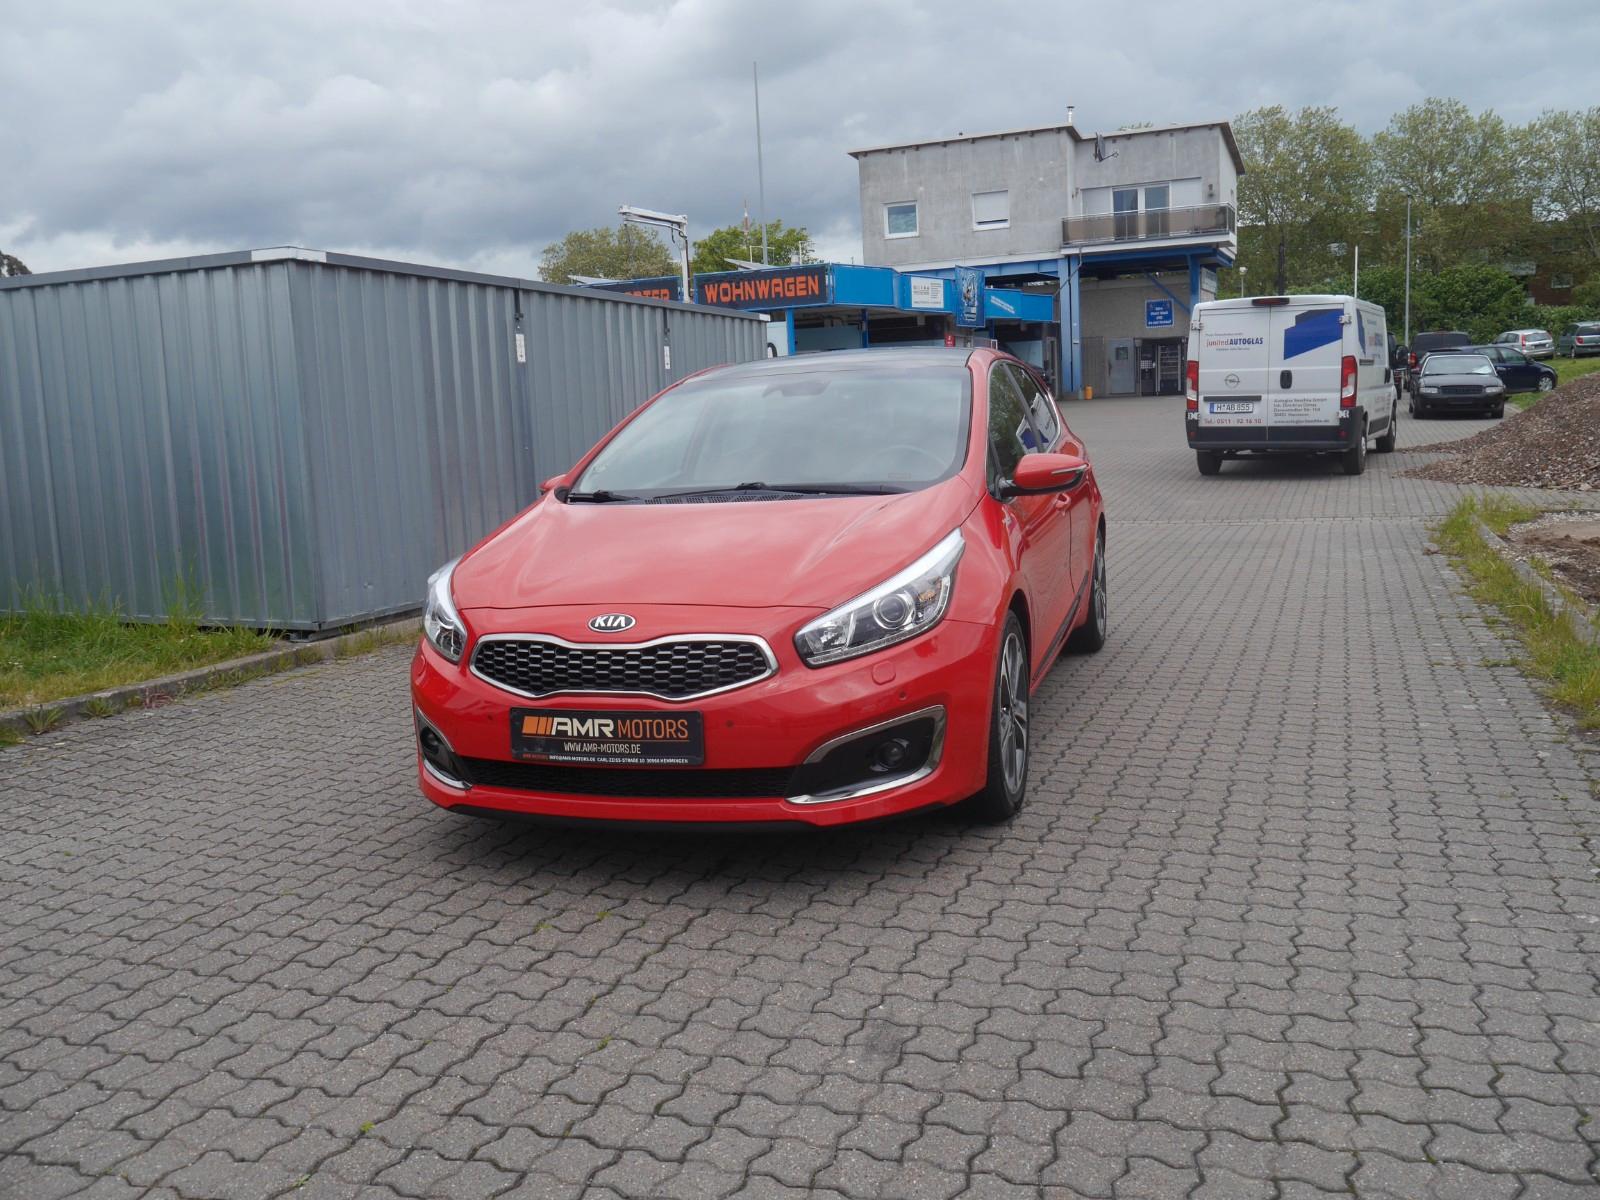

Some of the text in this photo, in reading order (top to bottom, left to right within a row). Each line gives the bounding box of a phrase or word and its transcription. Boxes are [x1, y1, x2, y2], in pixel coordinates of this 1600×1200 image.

[704, 275, 819, 304] WOHNWAGEN
[594, 615, 626, 627] KIA
[552, 718, 689, 740] AMR MOTORS
[563, 742, 641, 754] WWW.AMR-MOTORS.DE
